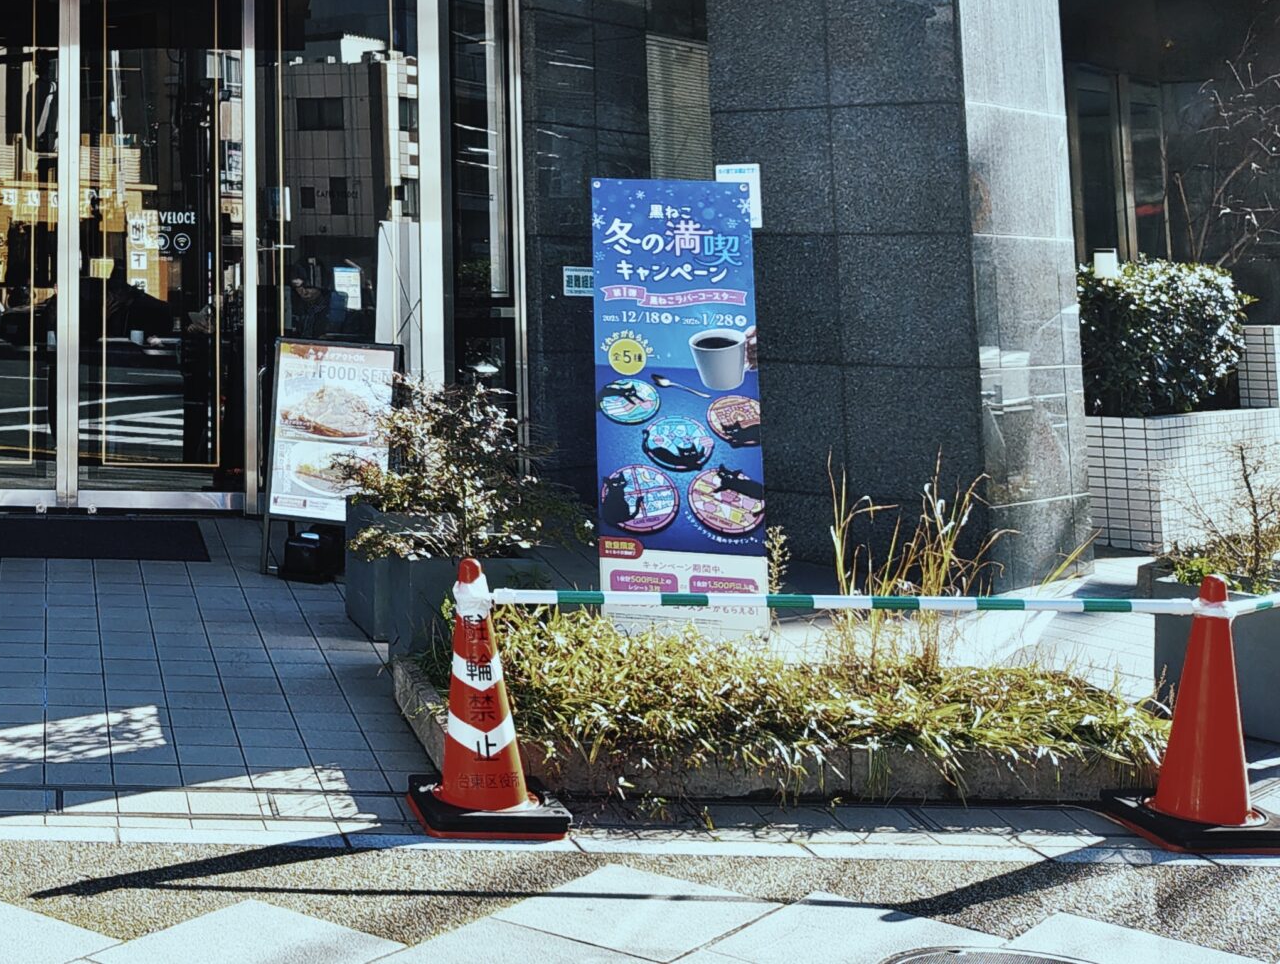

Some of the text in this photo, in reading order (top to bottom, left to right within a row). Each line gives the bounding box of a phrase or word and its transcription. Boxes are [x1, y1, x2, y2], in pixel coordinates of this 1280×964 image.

[159, 211, 196, 224] VELOCE
[648, 204, 691, 219] 黒ねこ
[603, 218, 743, 266] 冬の満喫
[616, 260, 727, 283] キャンペーン
[319, 364, 356, 381] FOOD
[463, 614, 500, 762] 駐輪禁止
